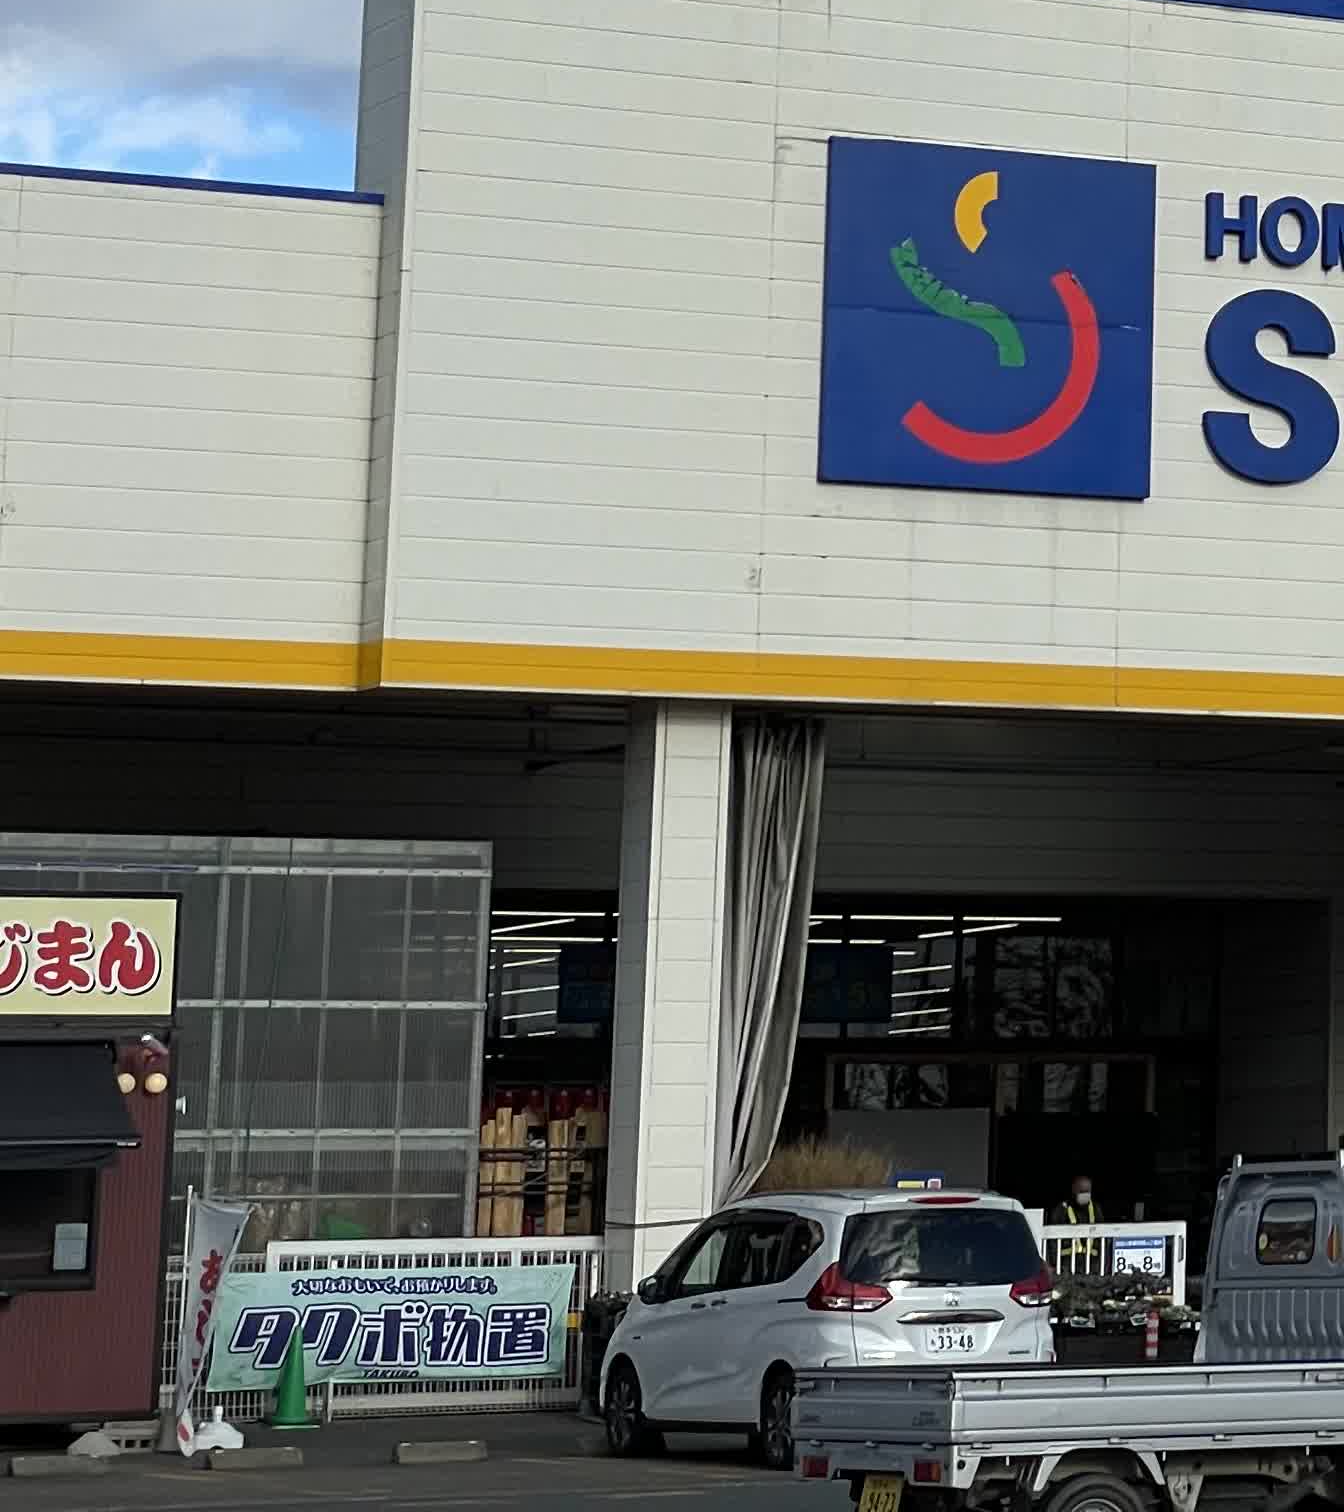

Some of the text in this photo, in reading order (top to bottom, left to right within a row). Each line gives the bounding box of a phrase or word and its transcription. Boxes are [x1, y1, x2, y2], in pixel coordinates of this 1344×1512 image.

[228, 1300, 552, 1369] タクボ物置
[938, 1335, 974, 1350] 33-48
